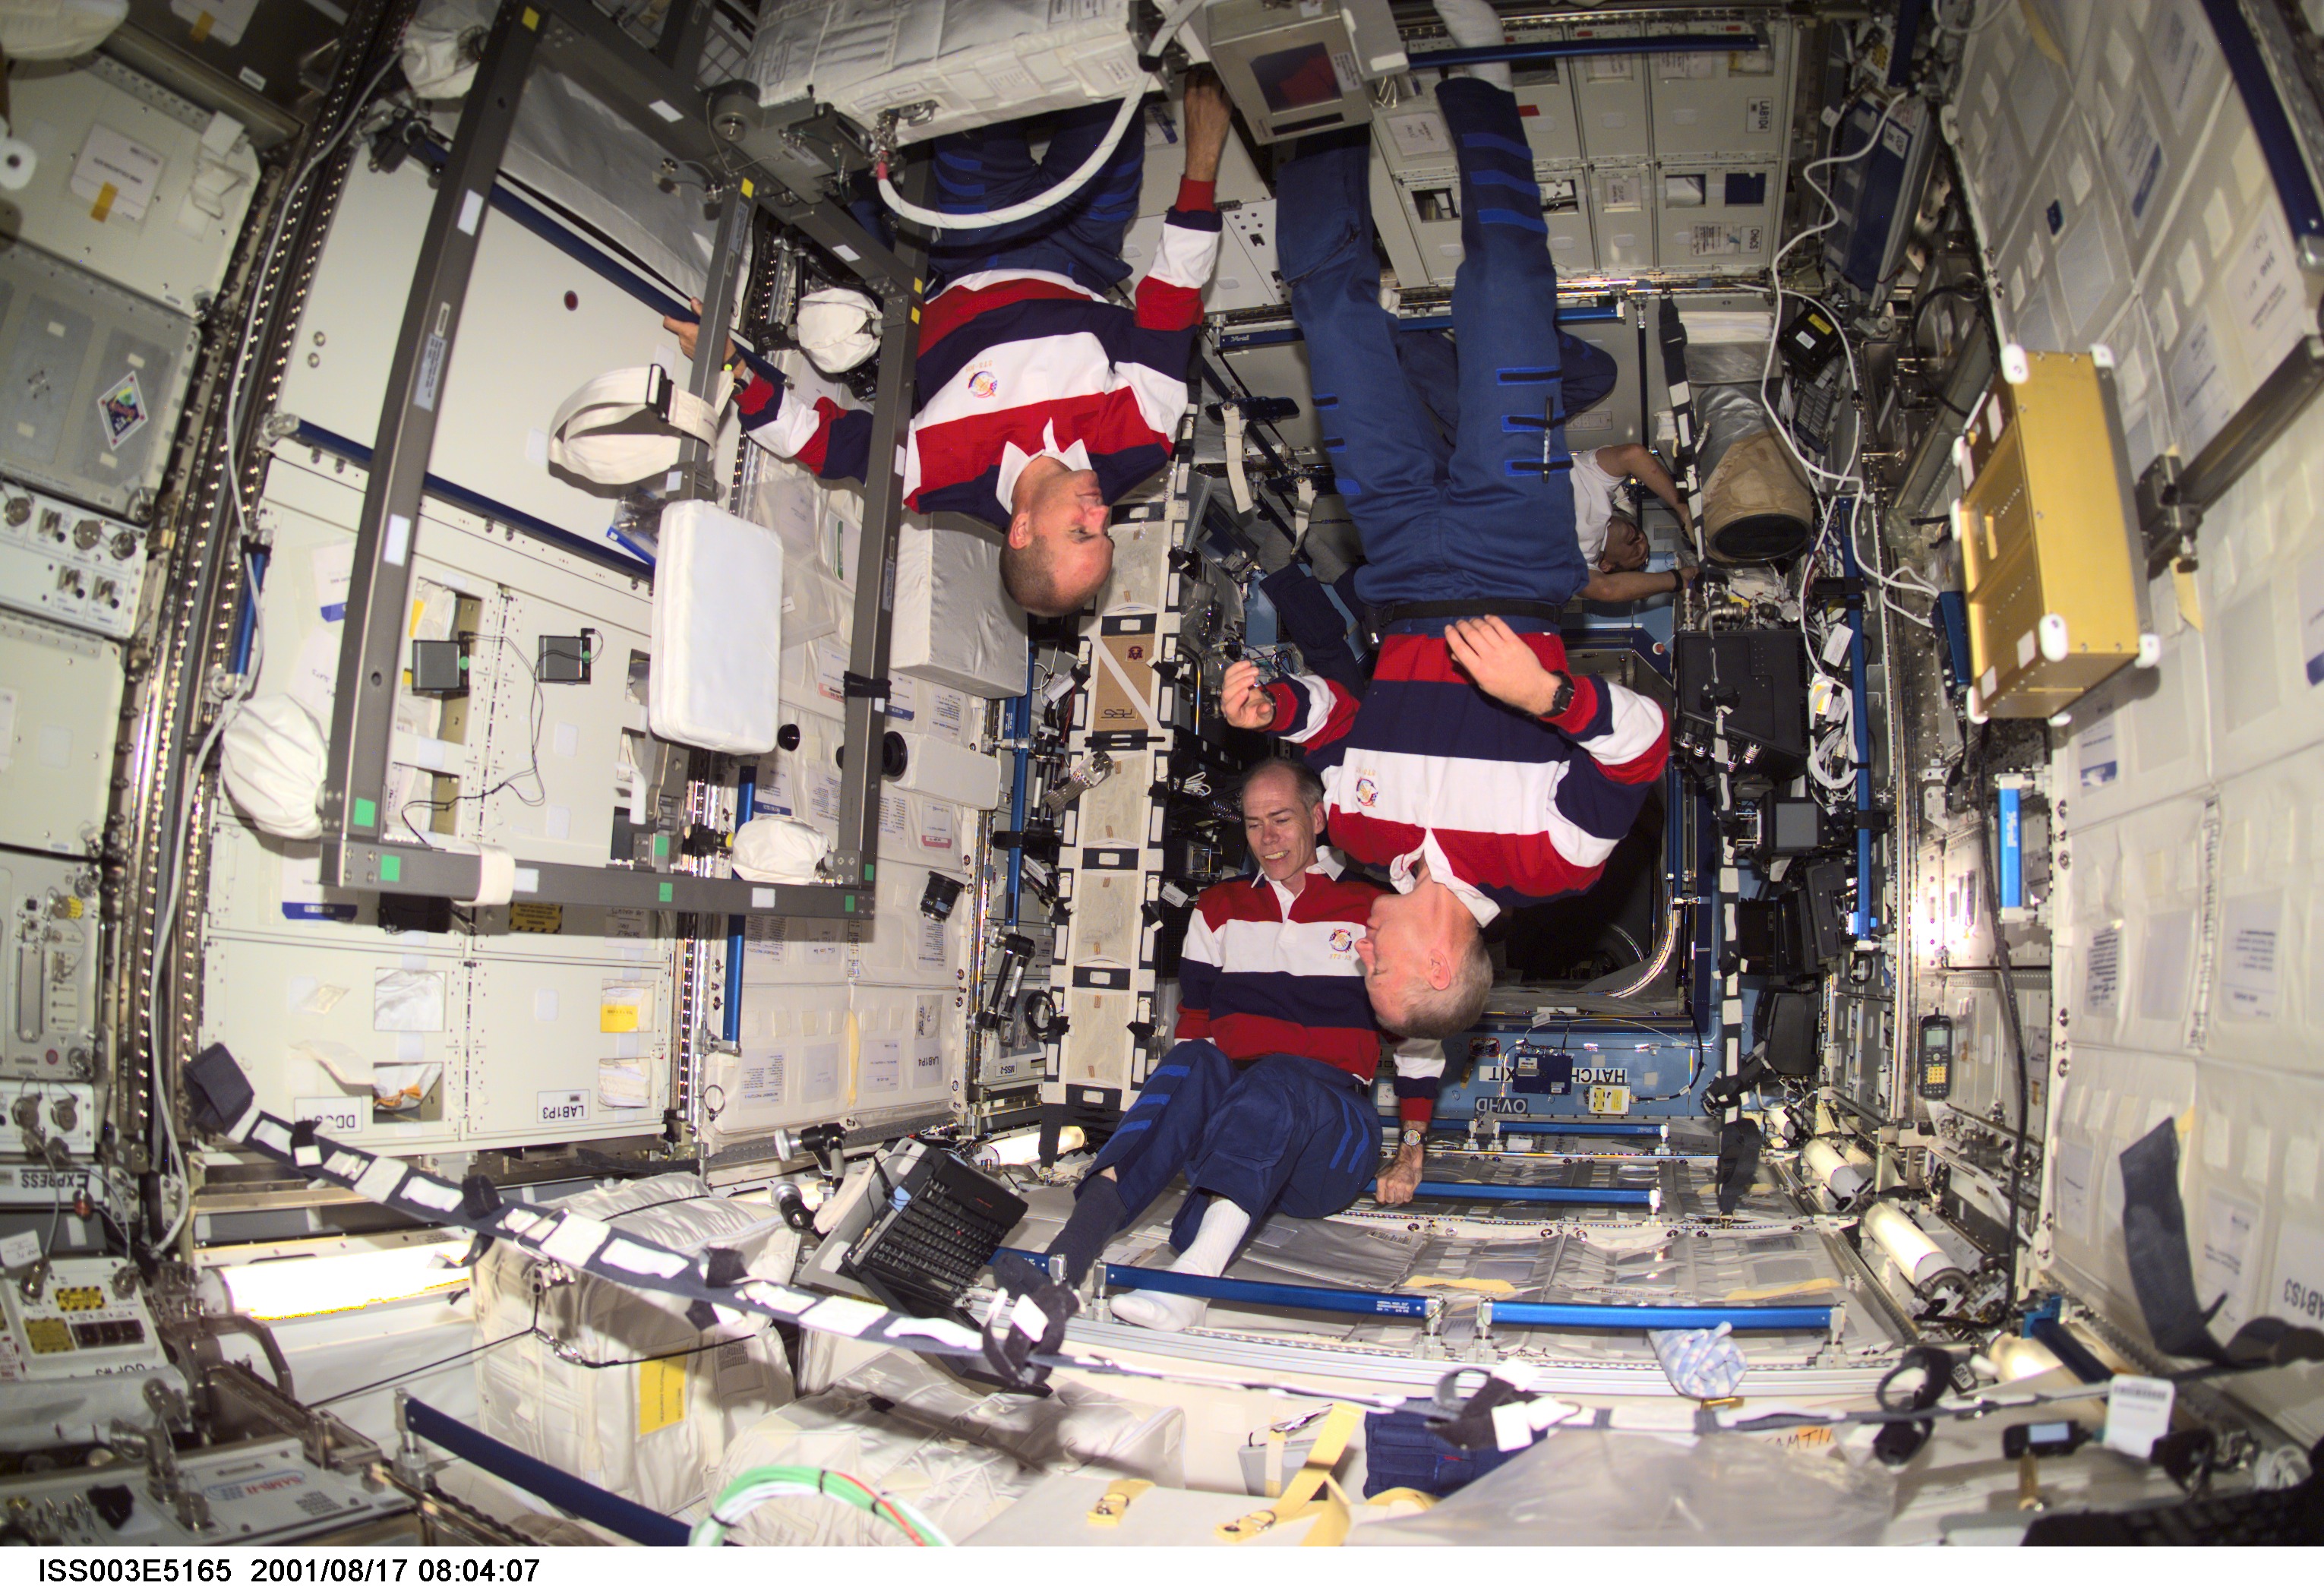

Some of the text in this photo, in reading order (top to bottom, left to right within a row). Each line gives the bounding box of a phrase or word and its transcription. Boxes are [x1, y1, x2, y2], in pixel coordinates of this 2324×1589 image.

[1758, 100, 1770, 130] LAB1D4
[917, 1056, 939, 1067] LAB1P4
[1489, 1066, 1515, 1082] XIT
[542, 1105, 585, 1120] LAB1P3
[1475, 1098, 1527, 1113] OVHD
[21, 1174, 90, 1191] EXPRESS
